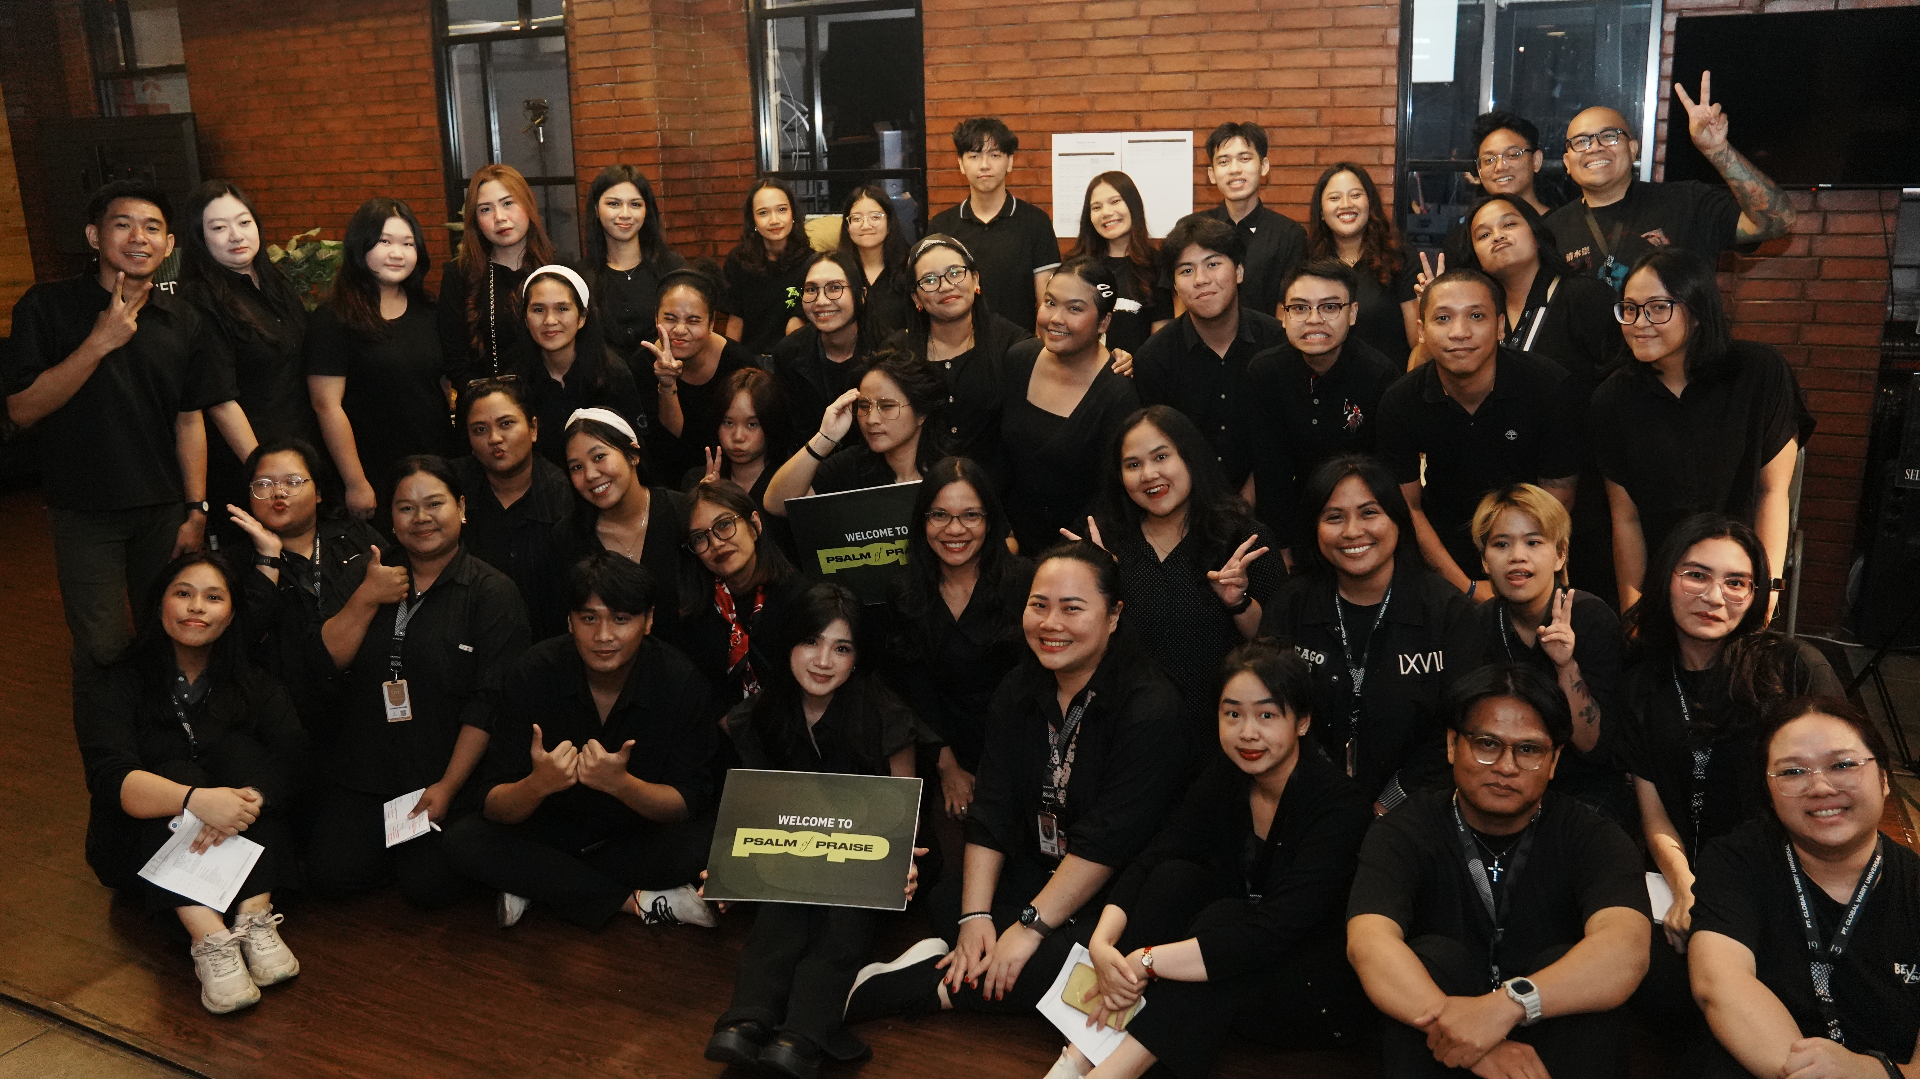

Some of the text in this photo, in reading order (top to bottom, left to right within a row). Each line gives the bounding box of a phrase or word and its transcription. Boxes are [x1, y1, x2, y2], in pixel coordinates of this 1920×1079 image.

[845, 526, 908, 542] WELCOME TO
[826, 552, 871, 563] PSALM
[778, 814, 852, 829] WELCOME TO
[743, 836, 873, 852] PSALM of PRAISE
[1785, 843, 1796, 872] UNIVERSAL
[1793, 872, 1802, 893] VARRY
[1840, 854, 1882, 935] PT. GLOBAL VARRY UNIVERSAL
[1799, 893, 1809, 918] GLOBAL
